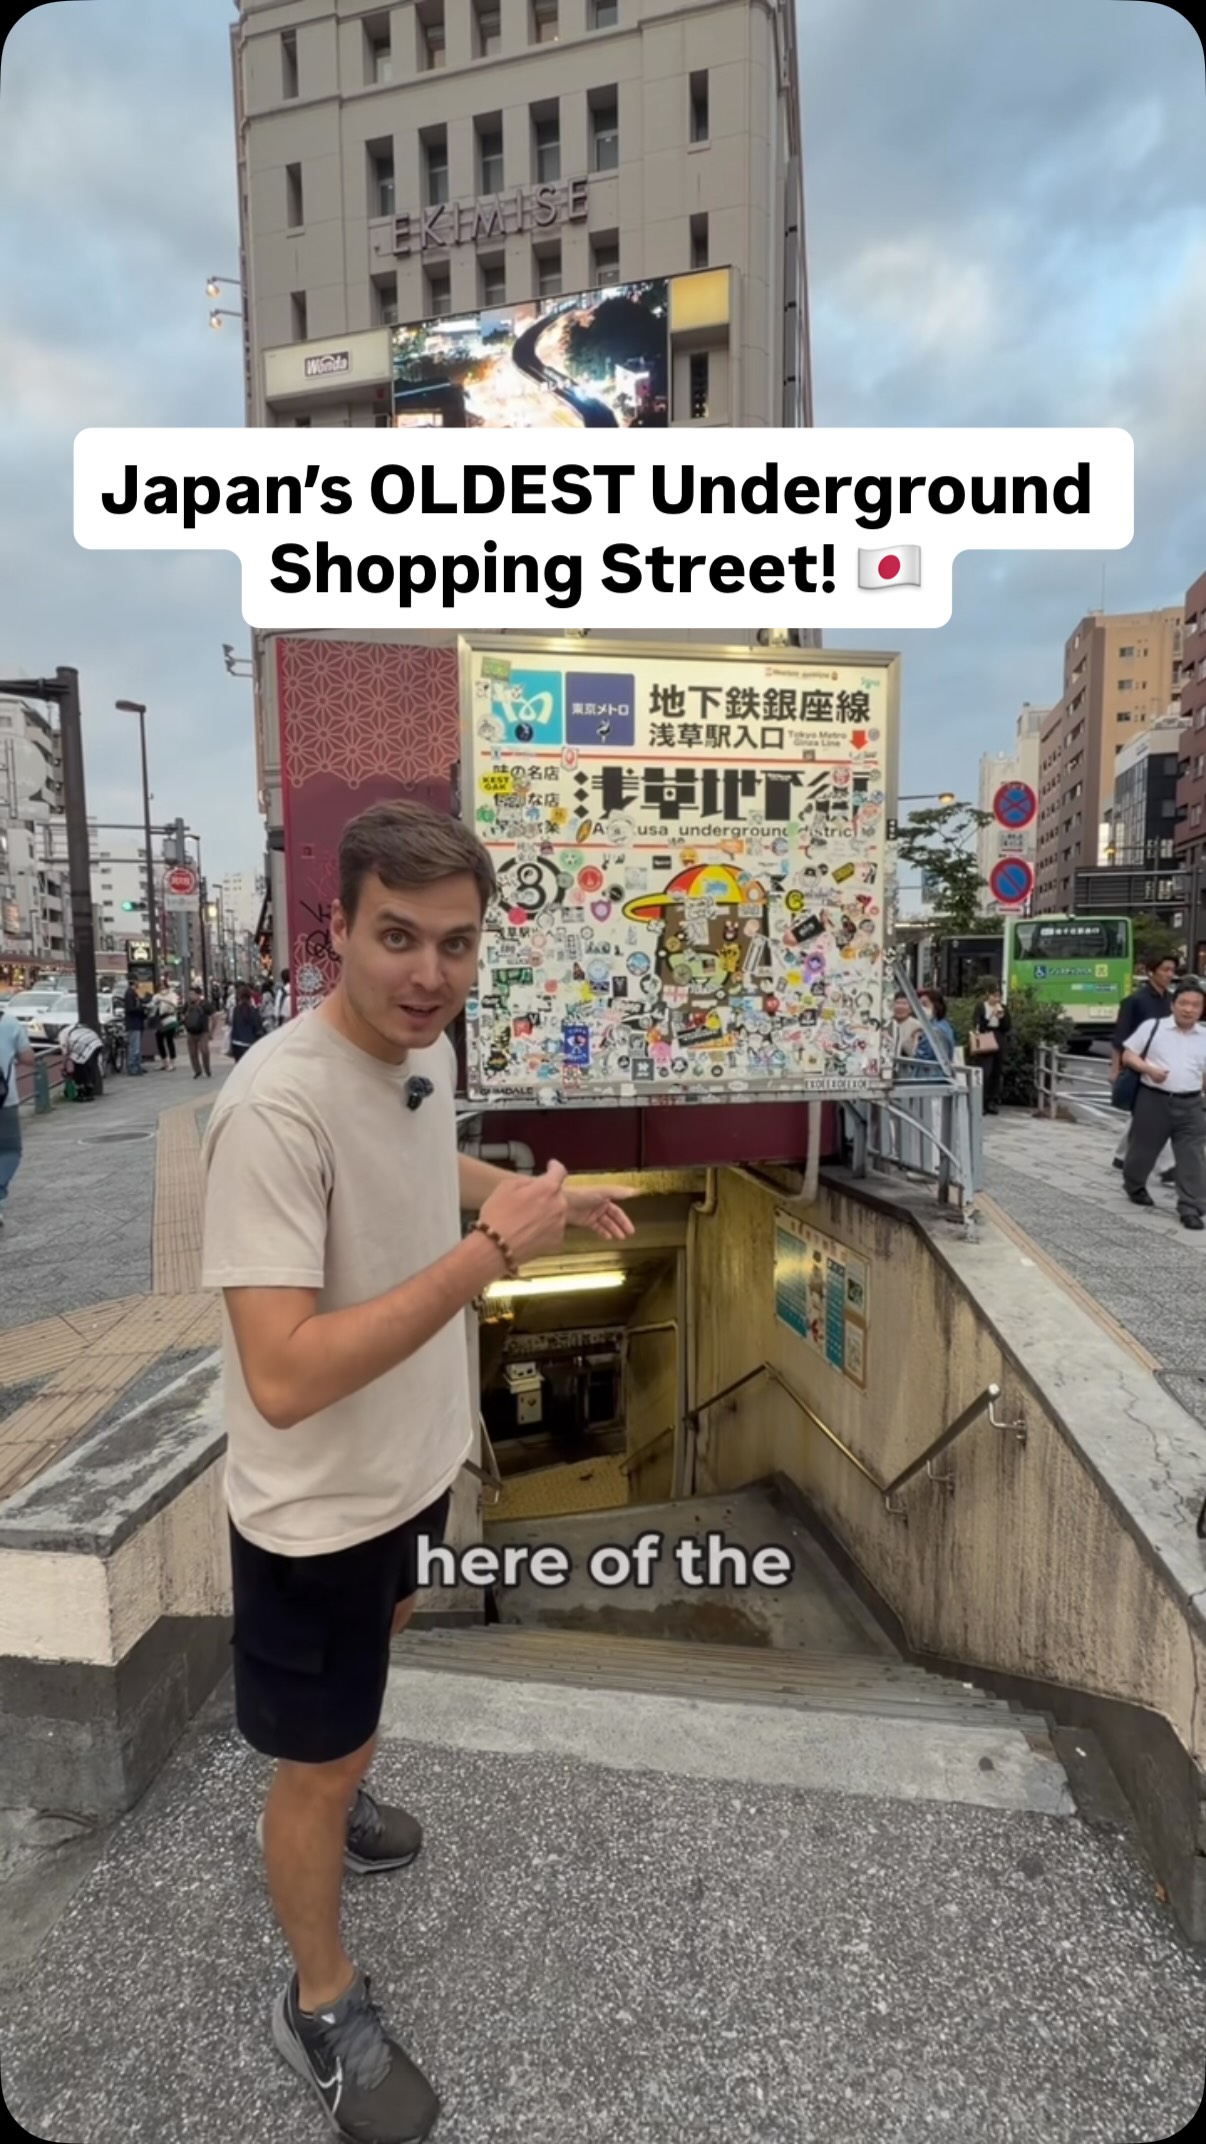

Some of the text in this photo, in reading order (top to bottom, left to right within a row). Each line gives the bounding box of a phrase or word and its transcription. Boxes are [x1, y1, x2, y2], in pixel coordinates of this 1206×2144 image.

[391, 177, 590, 256] EKIMISE
[571, 702, 630, 716] 東京メトロ
[649, 684, 871, 723] 地下鉄銀座線
[649, 722, 785, 749] 浅草駅入口
[788, 730, 848, 742] Tokyo Metro
[794, 739, 841, 748] Ginza Line
[592, 822, 669, 836] Ausa
